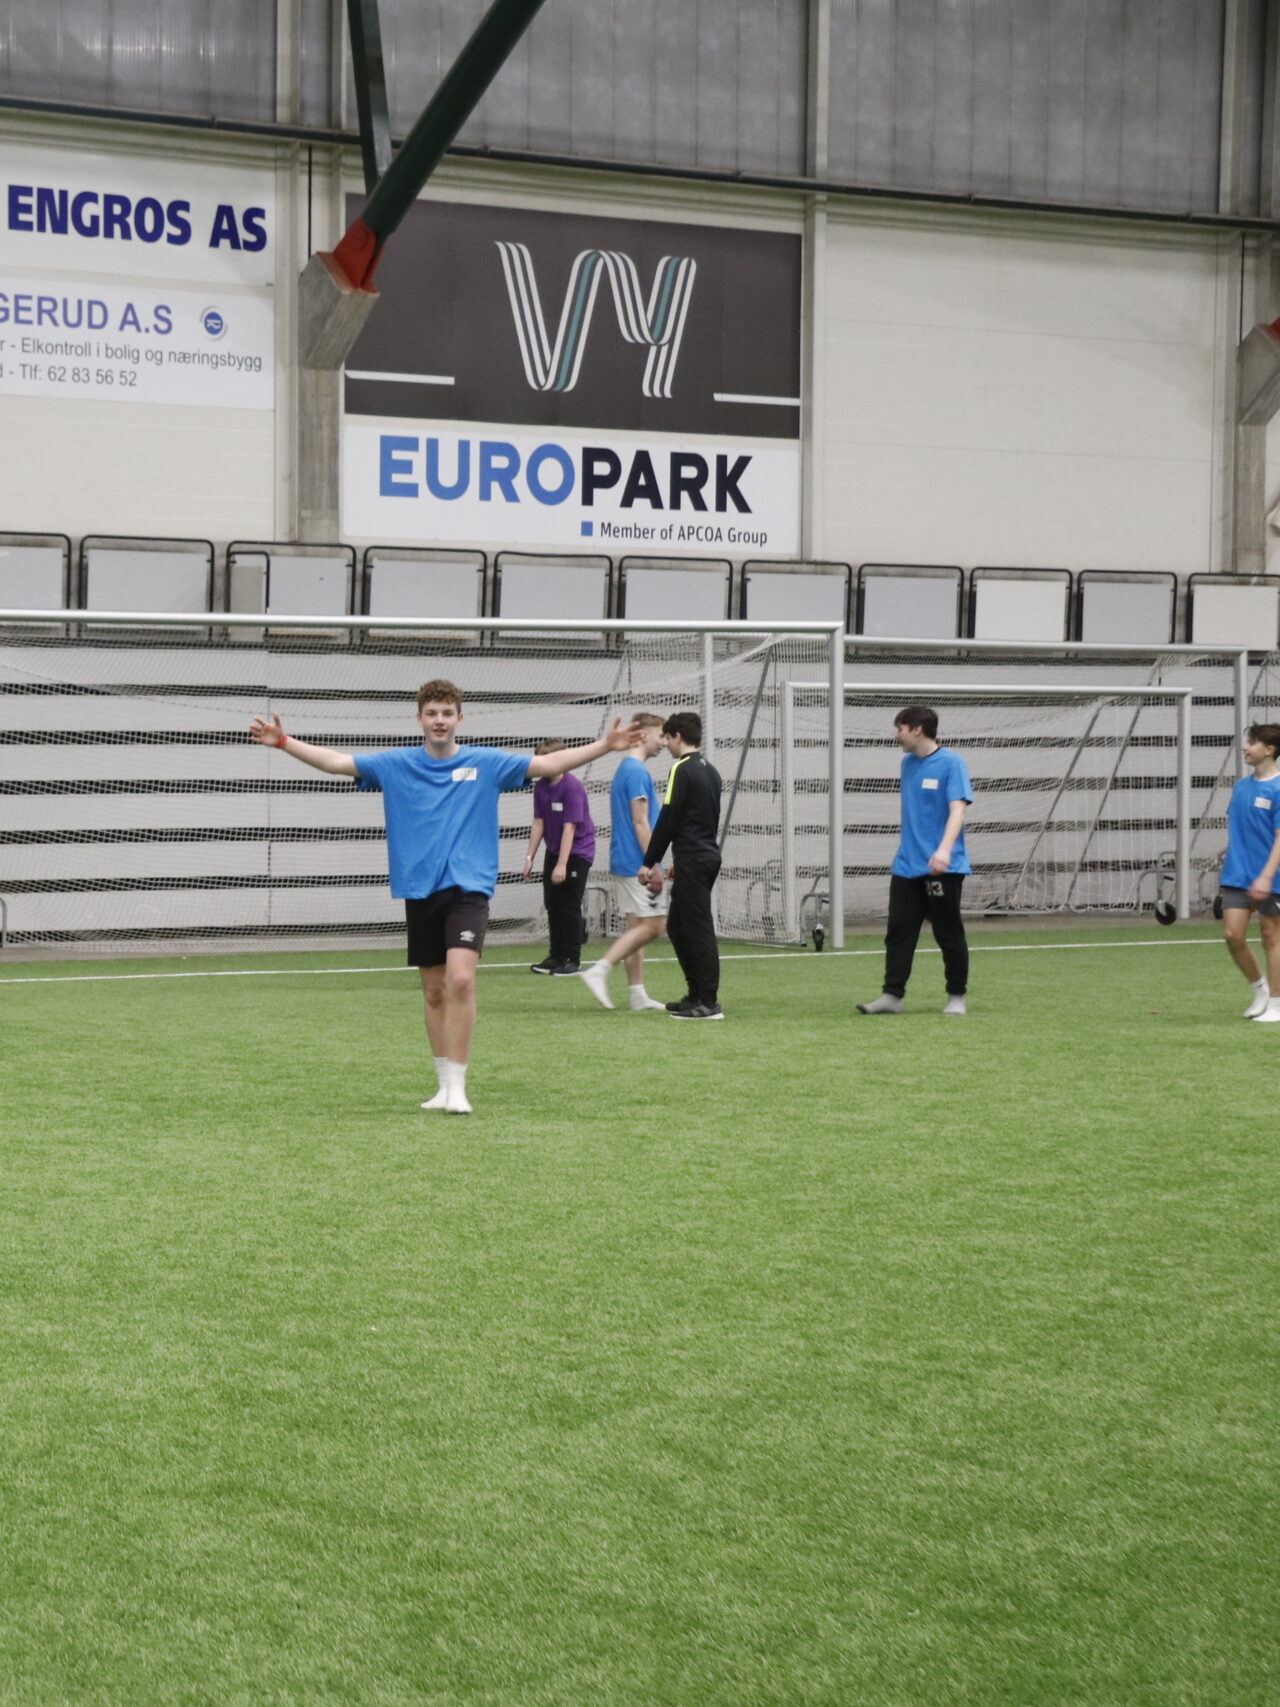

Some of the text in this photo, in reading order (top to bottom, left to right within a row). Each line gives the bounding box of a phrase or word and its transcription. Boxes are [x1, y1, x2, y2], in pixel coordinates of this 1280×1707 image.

[7, 184, 192, 246] ENGROS
[208, 204, 267, 253] AS
[119, 303, 173, 335] A.S
[21, 337, 91, 357] Elkontroll
[105, 343, 140, 364] bolig
[145, 350, 163, 366] og
[168, 350, 262, 372] næringsbygg
[19, 363, 42, 381] Tlf:
[47, 365, 67, 382] 62
[71, 367, 90, 384] 83
[95, 369, 114, 385] 56
[119, 370, 137, 387] 52
[379, 435, 753, 514] EUROPARK
[600, 521, 768, 548] Member of APCOA Group
